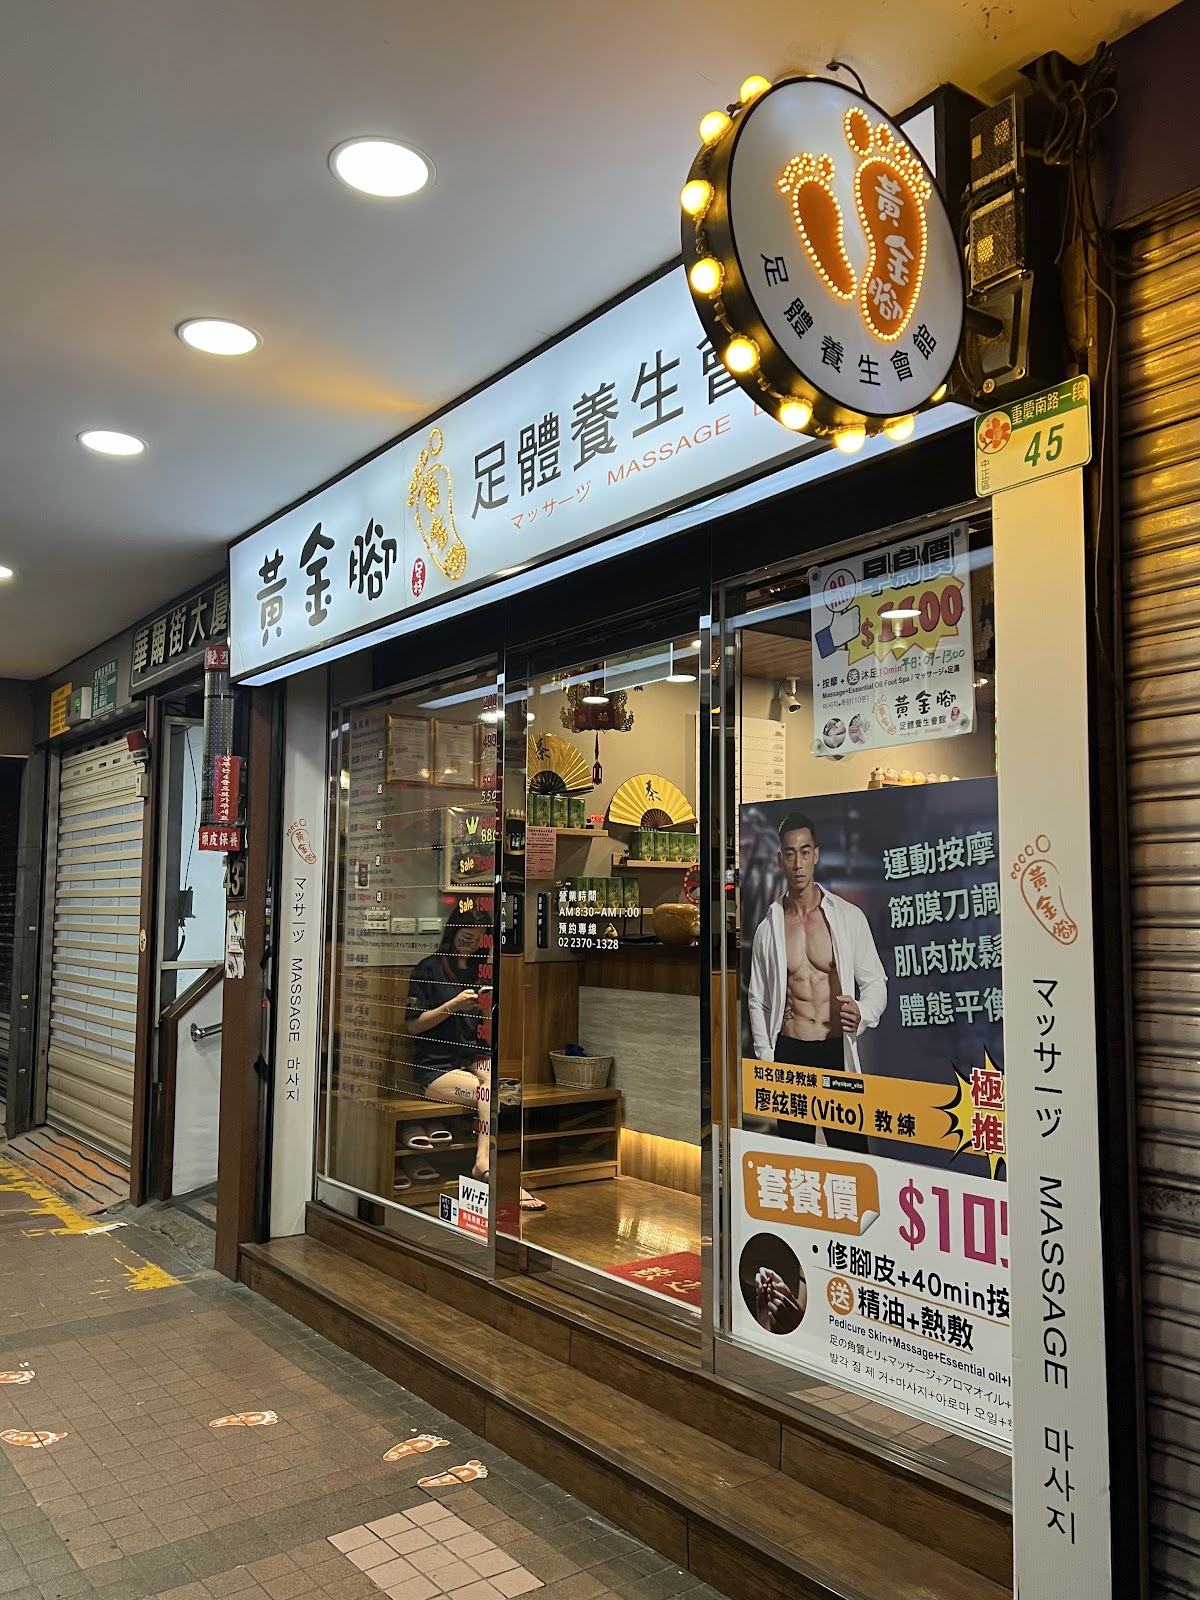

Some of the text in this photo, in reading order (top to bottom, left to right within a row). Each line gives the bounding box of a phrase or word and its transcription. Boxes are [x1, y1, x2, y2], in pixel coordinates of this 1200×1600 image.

[760, 252, 939, 387] 足體養生會館
[1011, 381, 1085, 425] 重慶南路一段
[606, 413, 732, 486] MASSAGE
[1023, 423, 1065, 467] 45
[256, 516, 398, 648] 黃金腳
[133, 583, 228, 673] 華爾街大廈
[861, 585, 964, 650] $1100
[884, 678, 898, 686] Foot
[898, 676, 910, 684] Spa
[894, 689, 957, 719] 黃金腳
[481, 790, 496, 802] 550
[459, 857, 474, 874] Sale
[883, 831, 995, 881] 運動按摩
[223, 862, 240, 896] 43
[458, 898, 474, 914] Sale
[888, 882, 1001, 929] 筋膜刀調
[558, 922, 597, 936] 預約專線
[558, 937, 619, 951] 02 2370-1328
[894, 933, 1003, 978] 肌肉放鬆
[288, 957, 303, 1043] MASSAGE
[285, 1057, 300, 1102] 마사지
[476, 1085, 490, 1102] 500
[754, 1066, 818, 1089] 知名健身教練
[462, 1185, 489, 1207] Wi-Fi
[756, 1164, 859, 1223] 套餐價
[1039, 1175, 1069, 1389] MASSAGE
[830, 1280, 974, 1352] 送 精油+熱敷
[829, 1314, 866, 1337] Pedicure
[868, 1328, 985, 1378] Skin+Massage+Essential
[1043, 1426, 1077, 1545] 마사지
